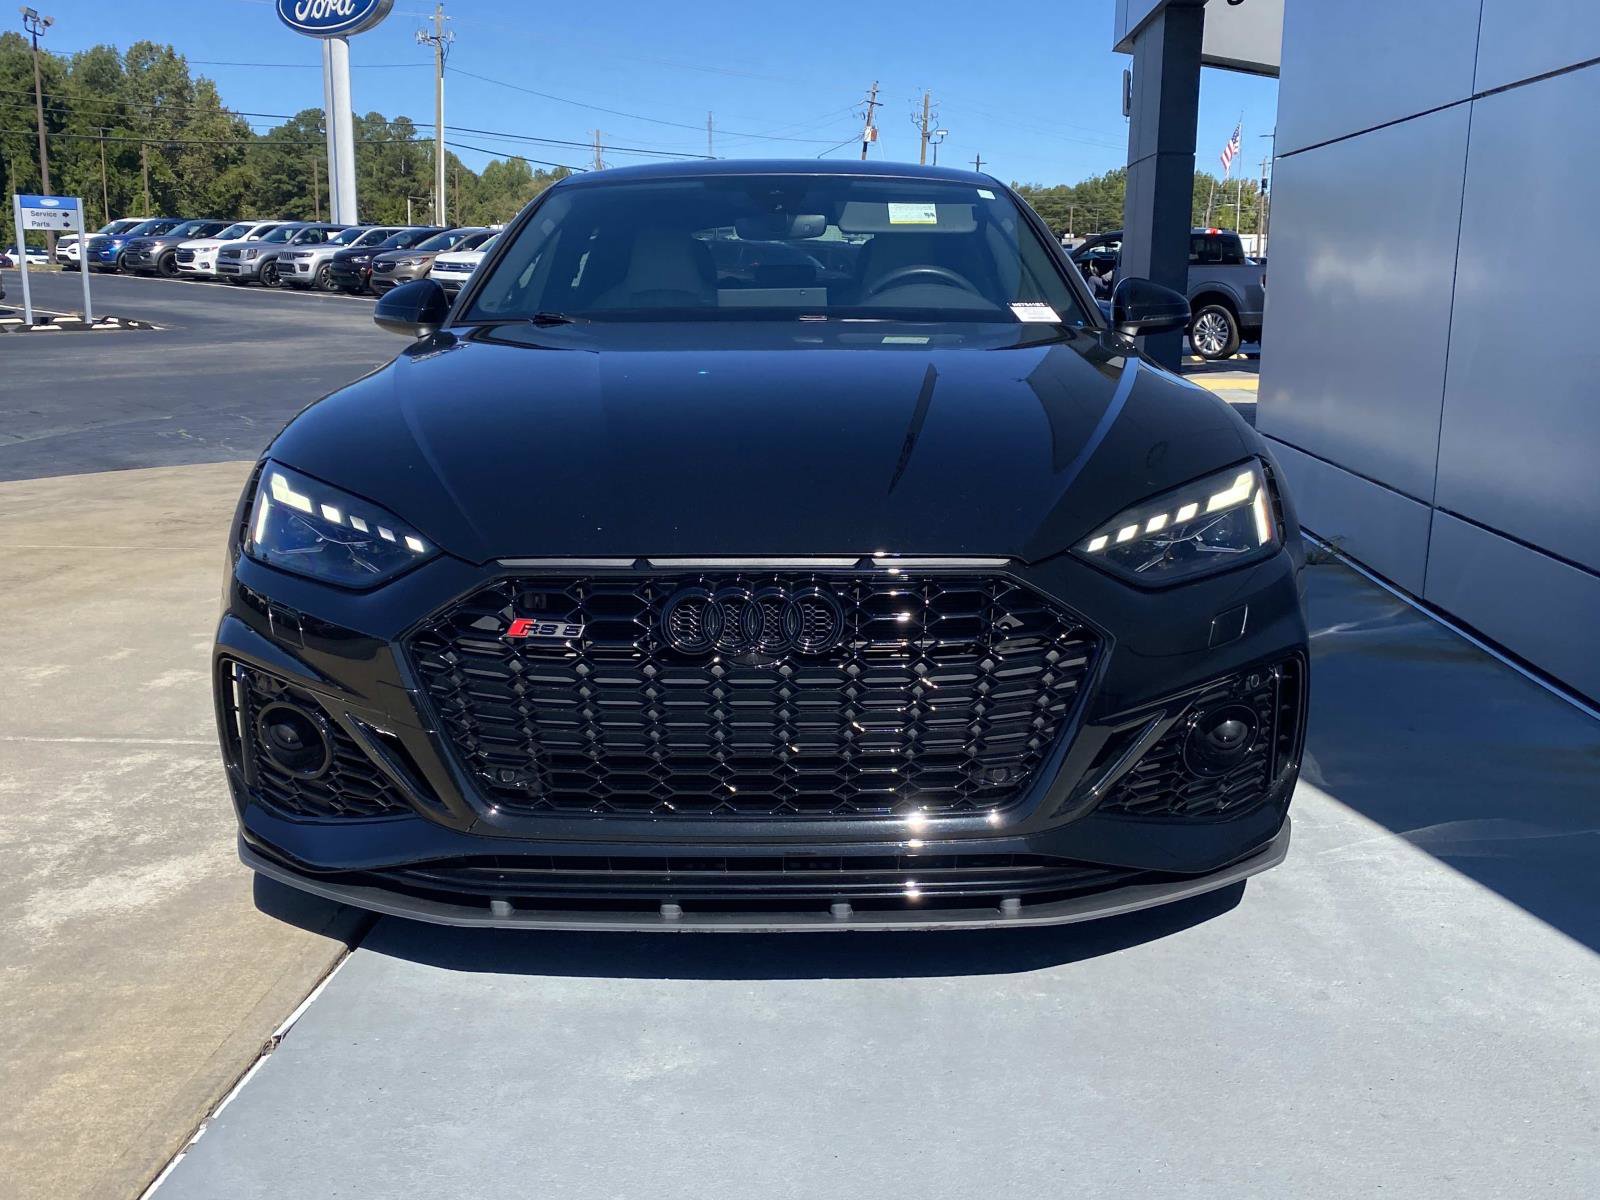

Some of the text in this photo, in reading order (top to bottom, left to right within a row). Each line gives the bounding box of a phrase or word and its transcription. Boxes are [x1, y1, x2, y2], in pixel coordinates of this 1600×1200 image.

[295, 0, 355, 20] Ford
[30, 210, 58, 218] Service
[31, 220, 50, 228] Parts
